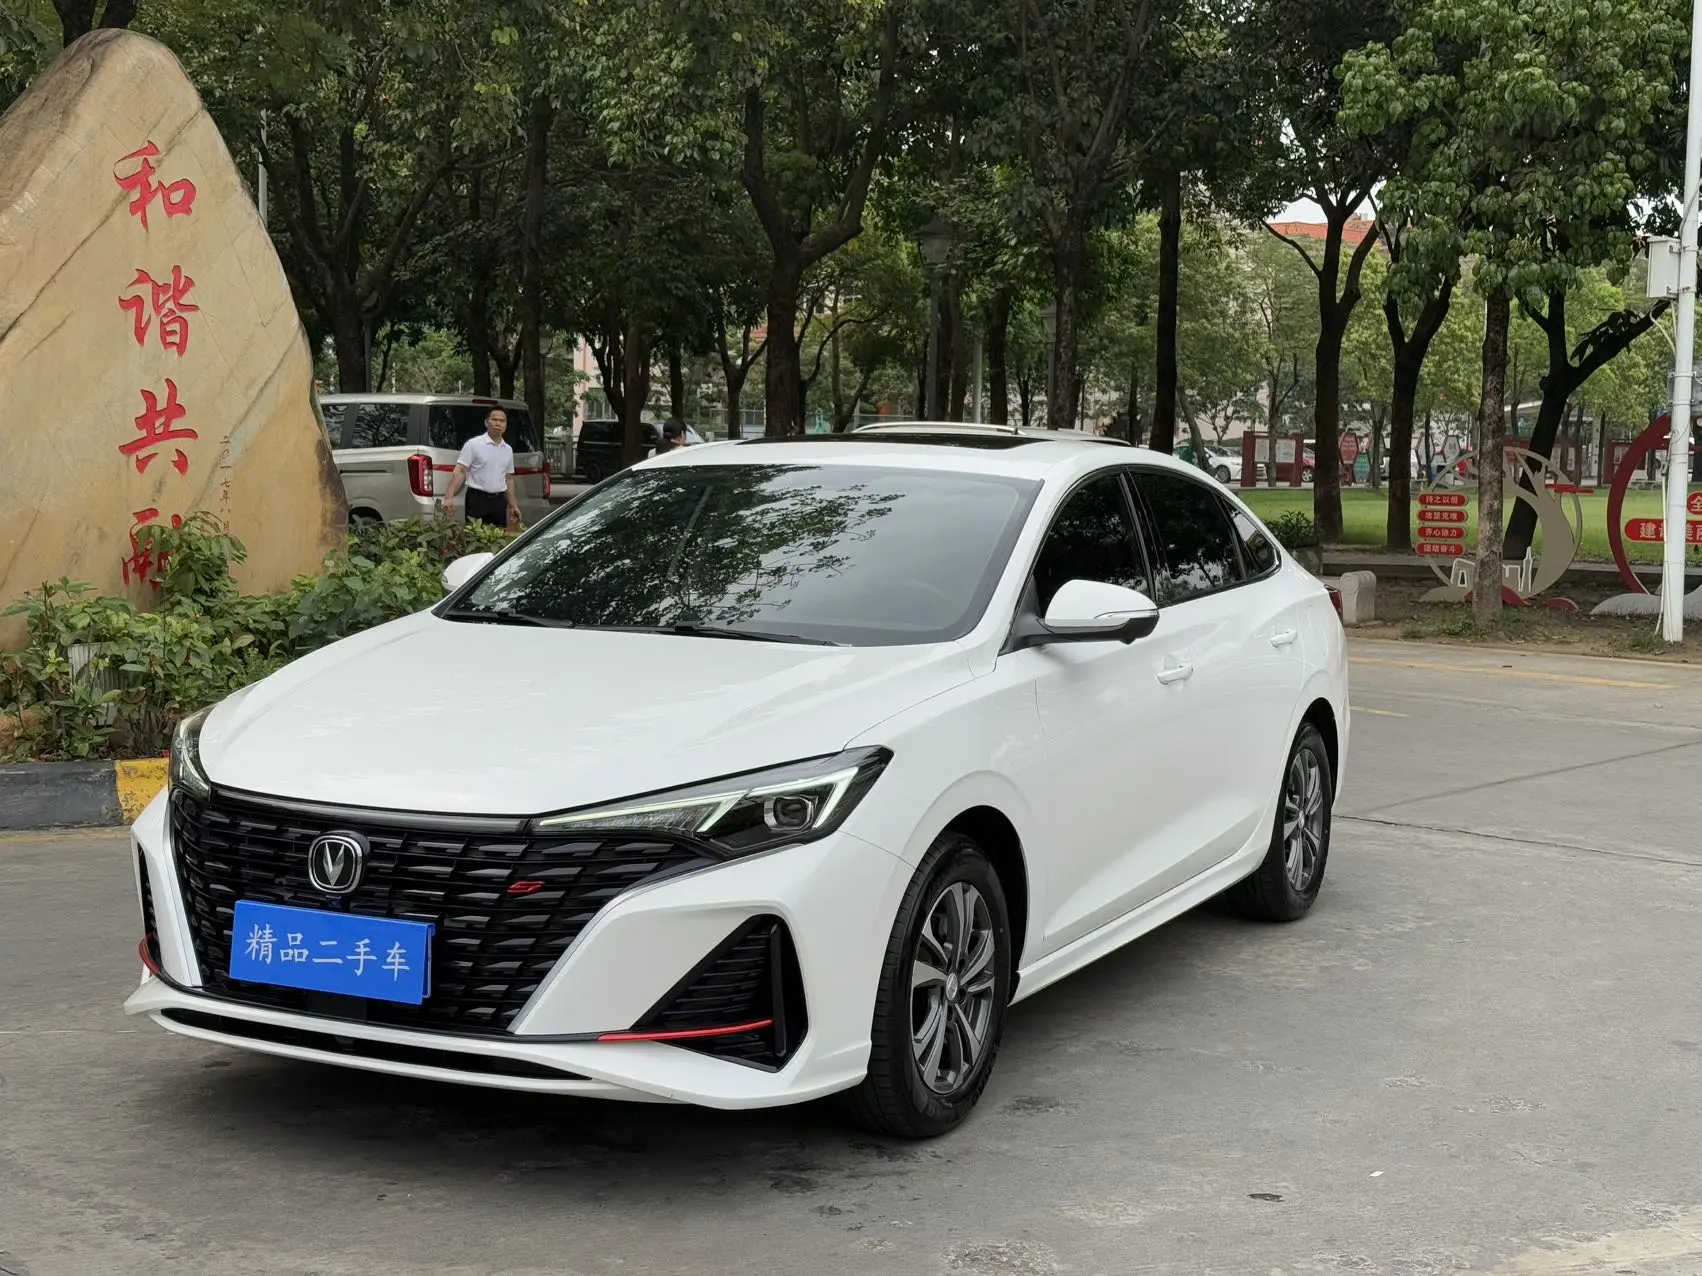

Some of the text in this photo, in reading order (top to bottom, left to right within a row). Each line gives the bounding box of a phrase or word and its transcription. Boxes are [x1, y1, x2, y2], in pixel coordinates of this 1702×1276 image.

[1426, 495, 1458, 504] 持之以恒
[1425, 528, 1457, 536] 齐心协力
[245, 923, 410, 981] 精品二手车
